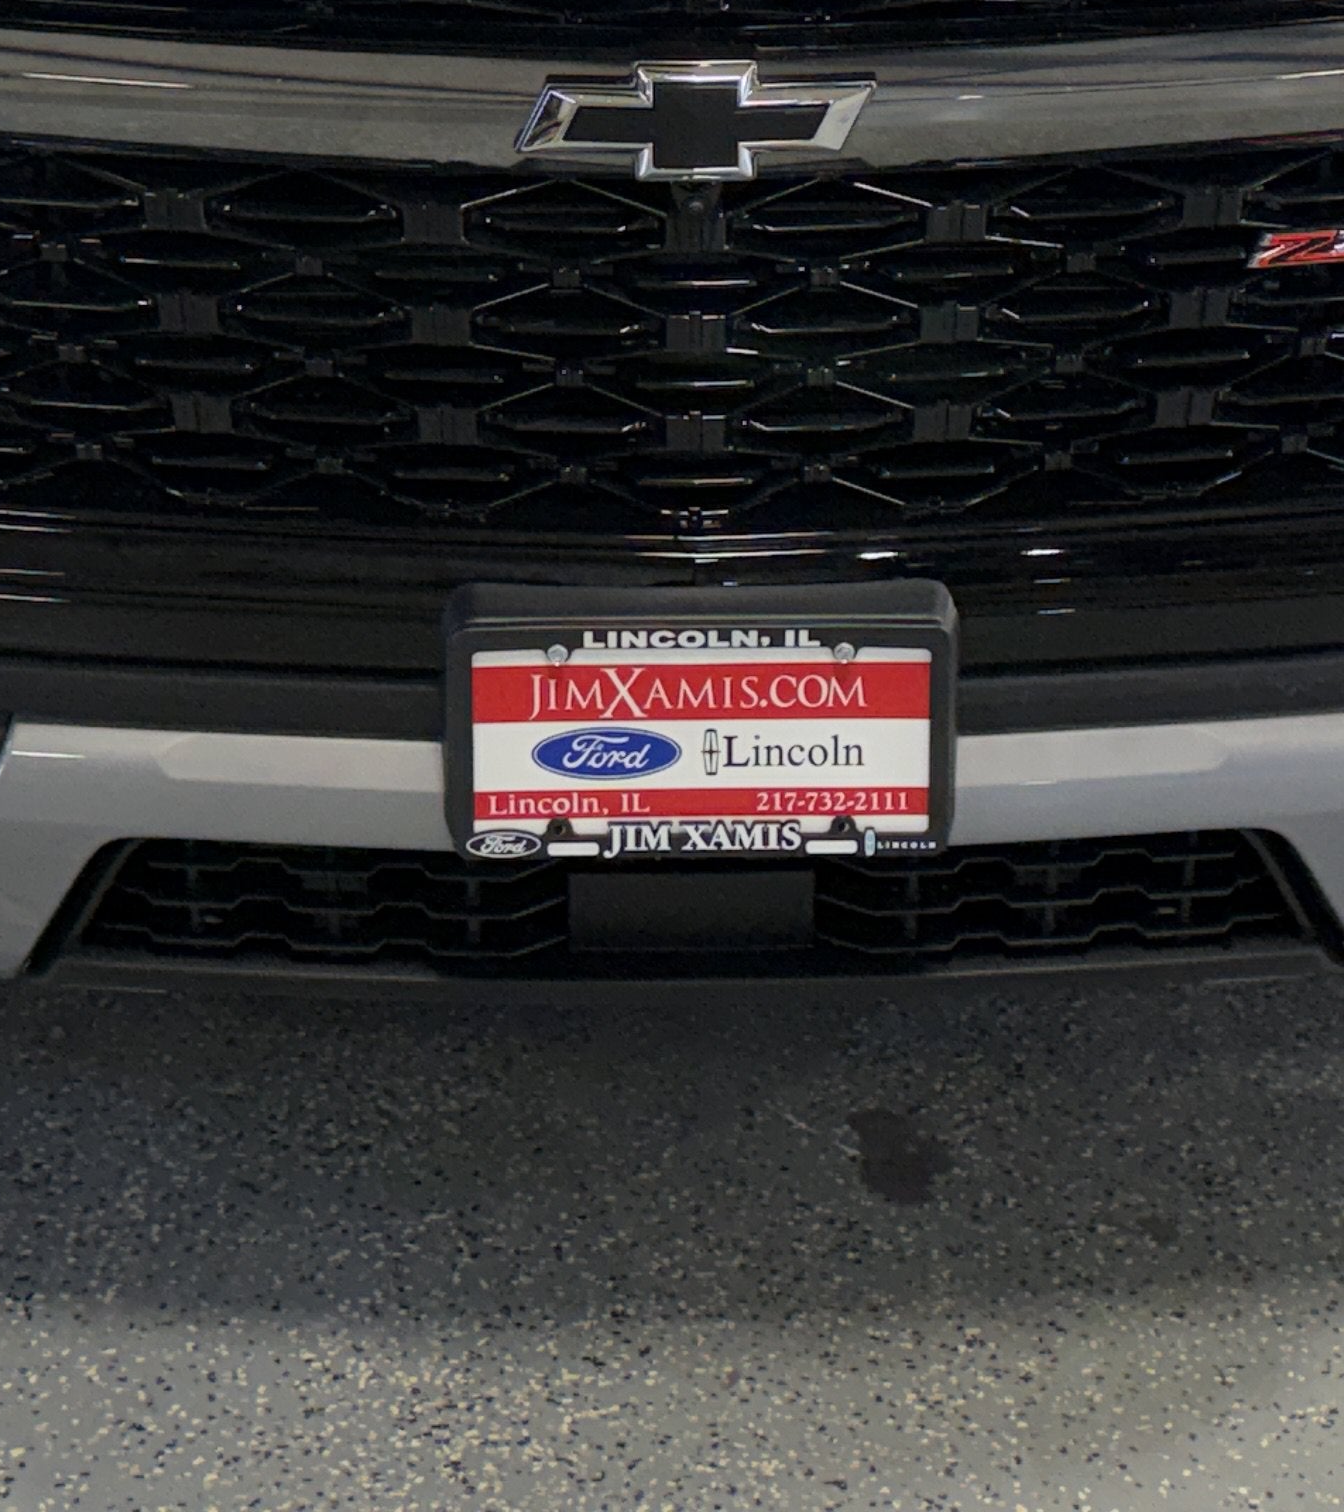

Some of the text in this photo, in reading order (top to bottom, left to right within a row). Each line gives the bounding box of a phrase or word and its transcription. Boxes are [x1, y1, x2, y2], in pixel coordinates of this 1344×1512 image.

[583, 629, 822, 649] LINCOLN, IL
[562, 735, 650, 772] Ford
[723, 735, 865, 768] Lincoln
[488, 793, 651, 816] Lincoln, IL
[756, 791, 908, 812] 217-732-2111
[479, 836, 528, 855] Ford
[604, 820, 802, 859] JIM XAMIS
[877, 841, 937, 850] LINCOLN
